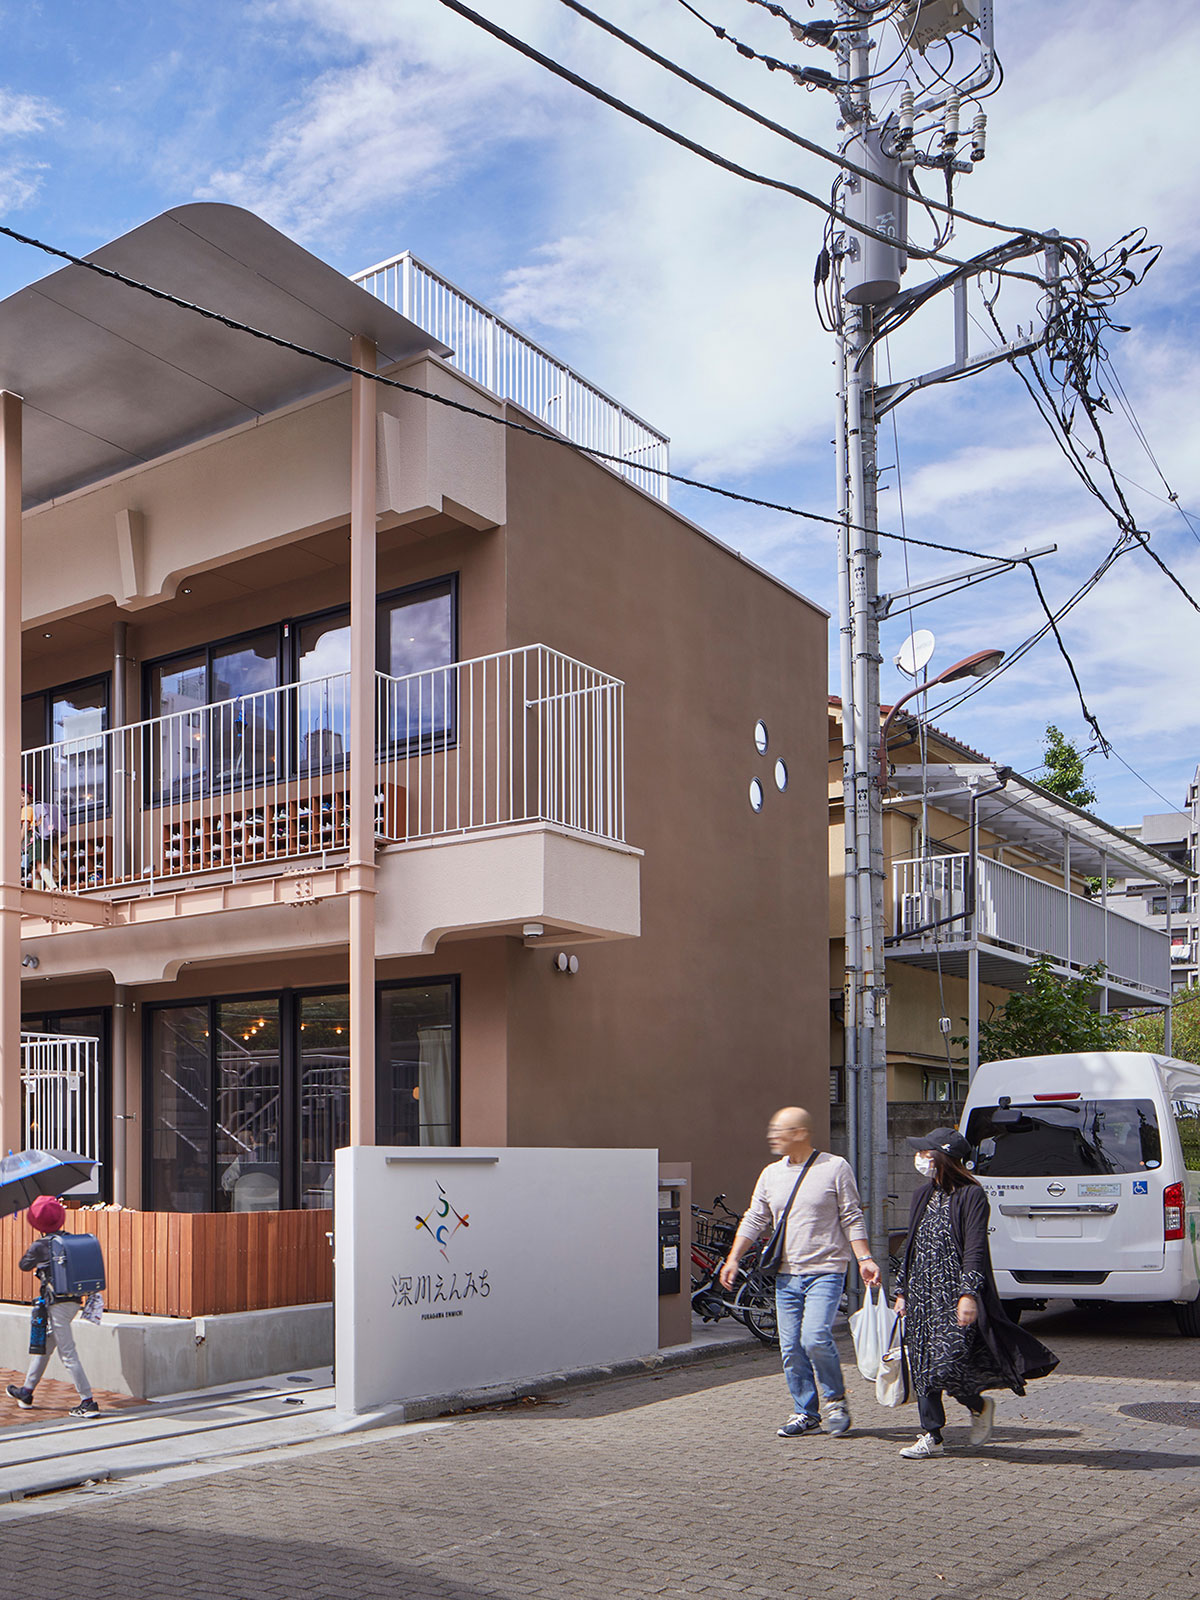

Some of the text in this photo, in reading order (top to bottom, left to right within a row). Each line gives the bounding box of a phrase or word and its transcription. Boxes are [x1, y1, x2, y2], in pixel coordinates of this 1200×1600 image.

[391, 1269, 491, 1307] 深川えんみち
